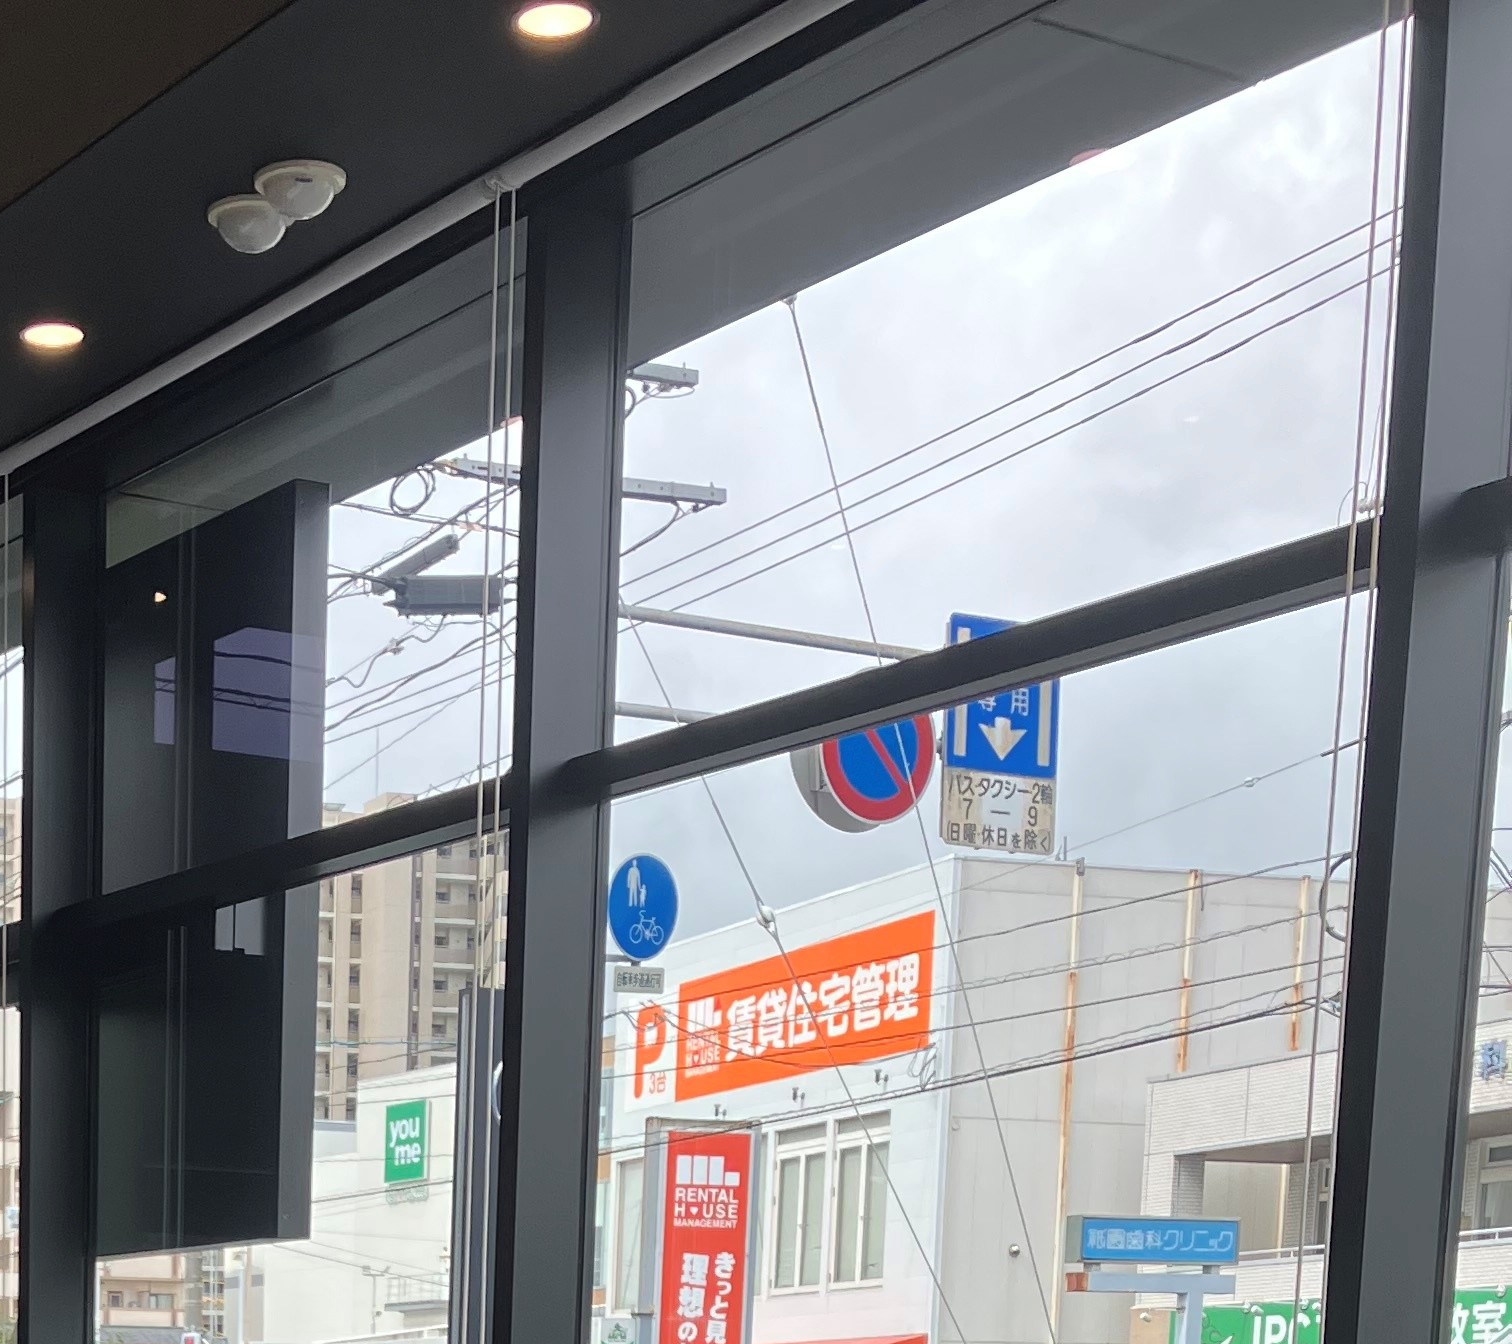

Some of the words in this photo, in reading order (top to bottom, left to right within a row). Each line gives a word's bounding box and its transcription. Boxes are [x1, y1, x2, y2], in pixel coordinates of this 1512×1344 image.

[725, 953, 920, 1062] 賃貸住宅管理
[389, 1117, 420, 1148] you
[394, 1142, 422, 1166] me
[674, 1187, 739, 1203] RENTAL
[673, 1217, 737, 1229] MANAGEMENT
